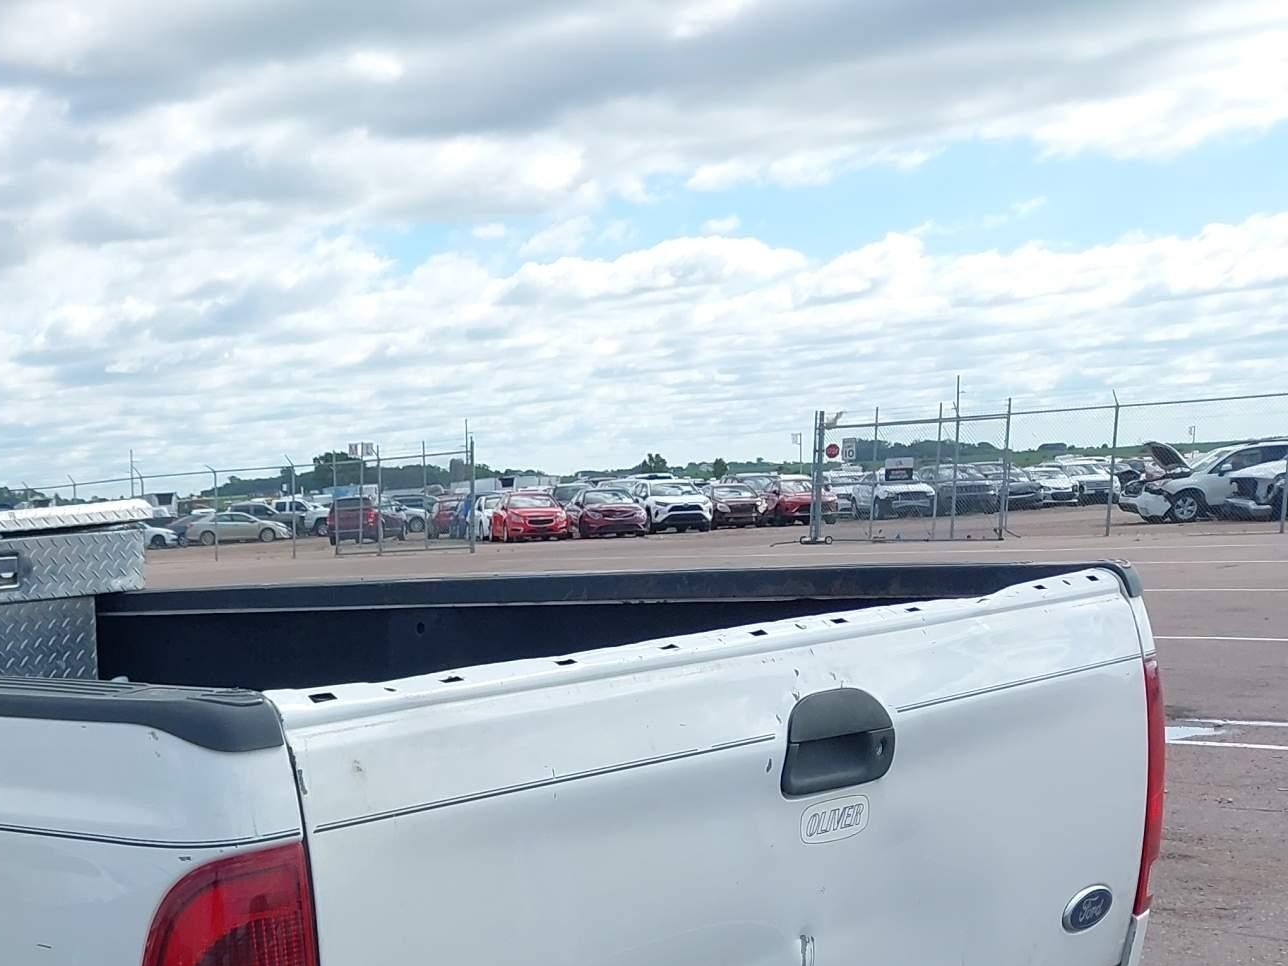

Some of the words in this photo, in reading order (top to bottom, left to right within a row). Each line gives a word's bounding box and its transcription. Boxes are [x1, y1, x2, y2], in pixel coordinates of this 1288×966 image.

[844, 449, 855, 458] 10
[806, 803, 864, 837] OLIVER
[1078, 895, 1105, 922] Ford
